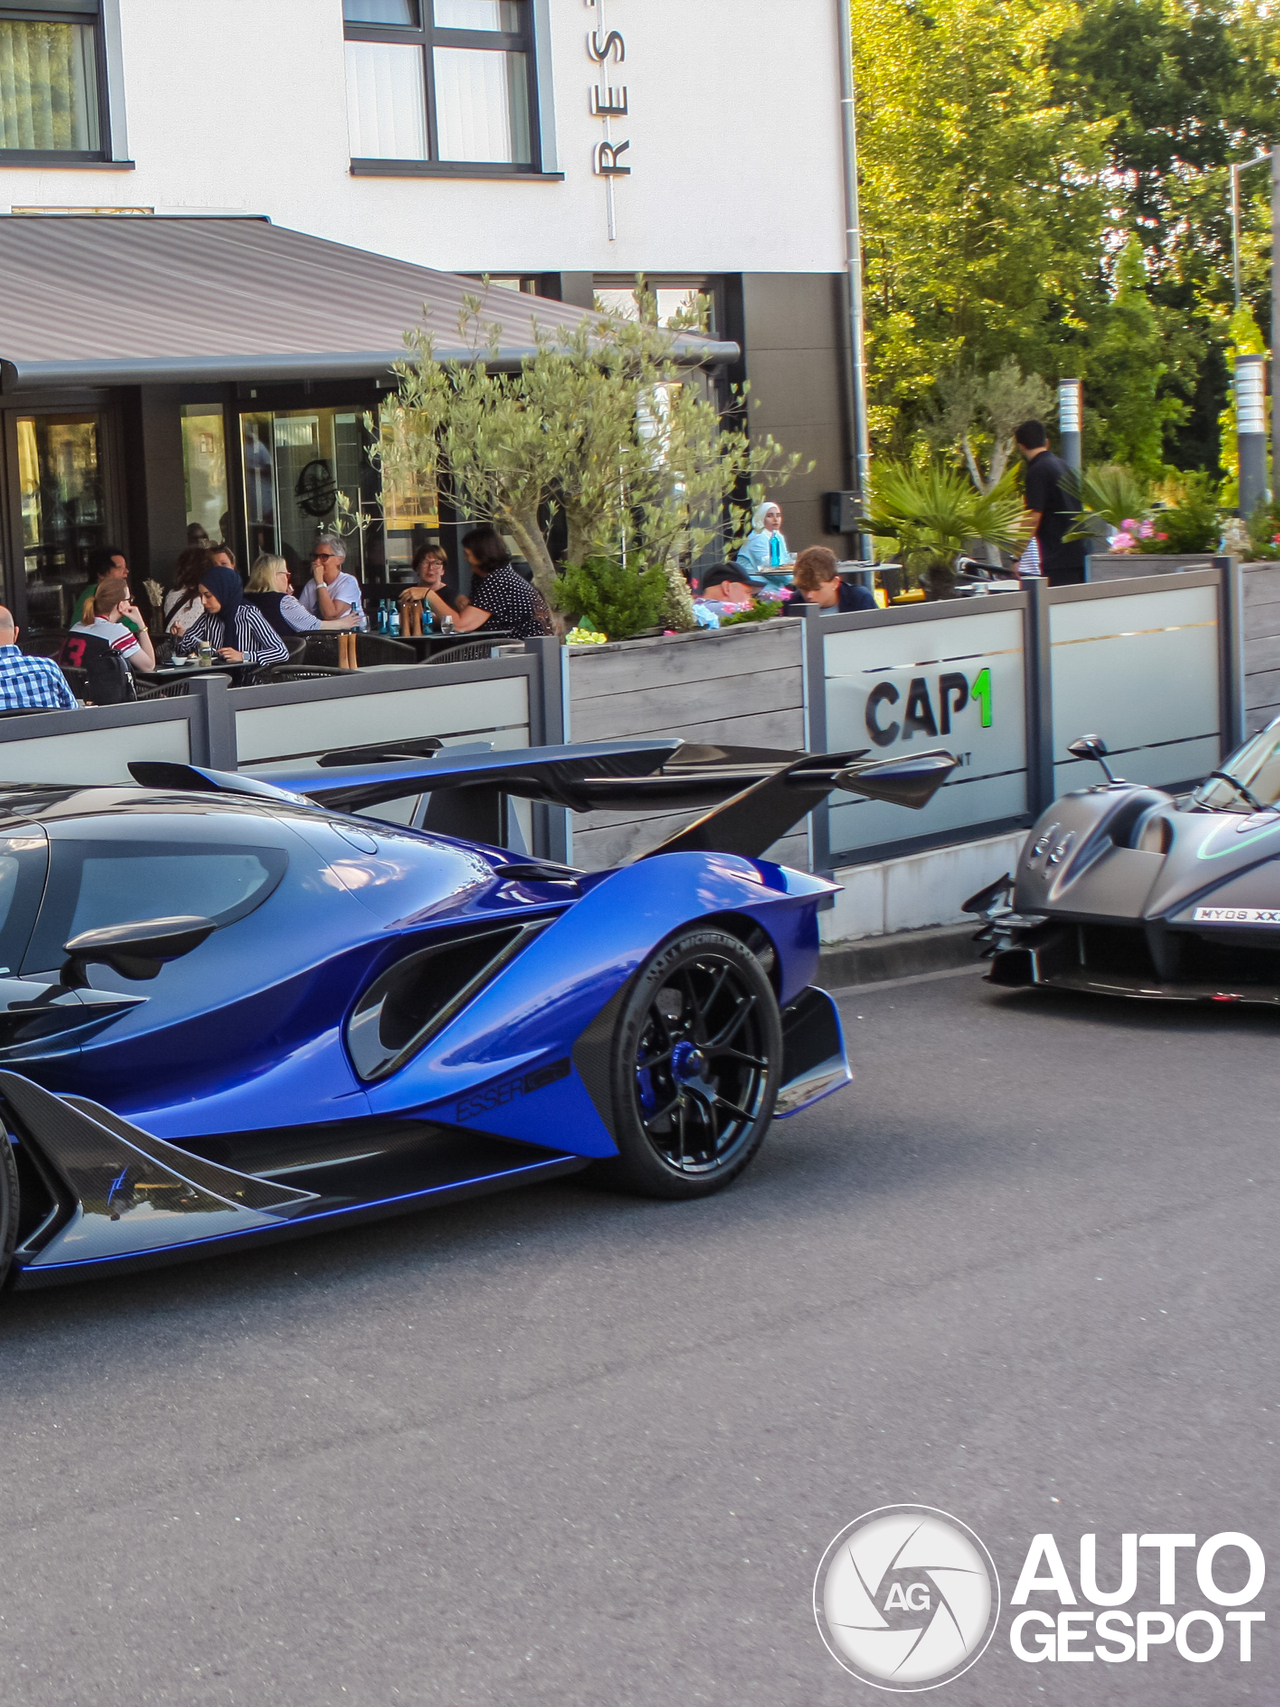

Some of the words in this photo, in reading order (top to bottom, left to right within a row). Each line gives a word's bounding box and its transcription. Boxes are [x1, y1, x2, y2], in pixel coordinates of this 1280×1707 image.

[586, 0, 632, 175] RES
[865, 667, 993, 747] CAP1
[1254, 911, 1280, 922] XX
